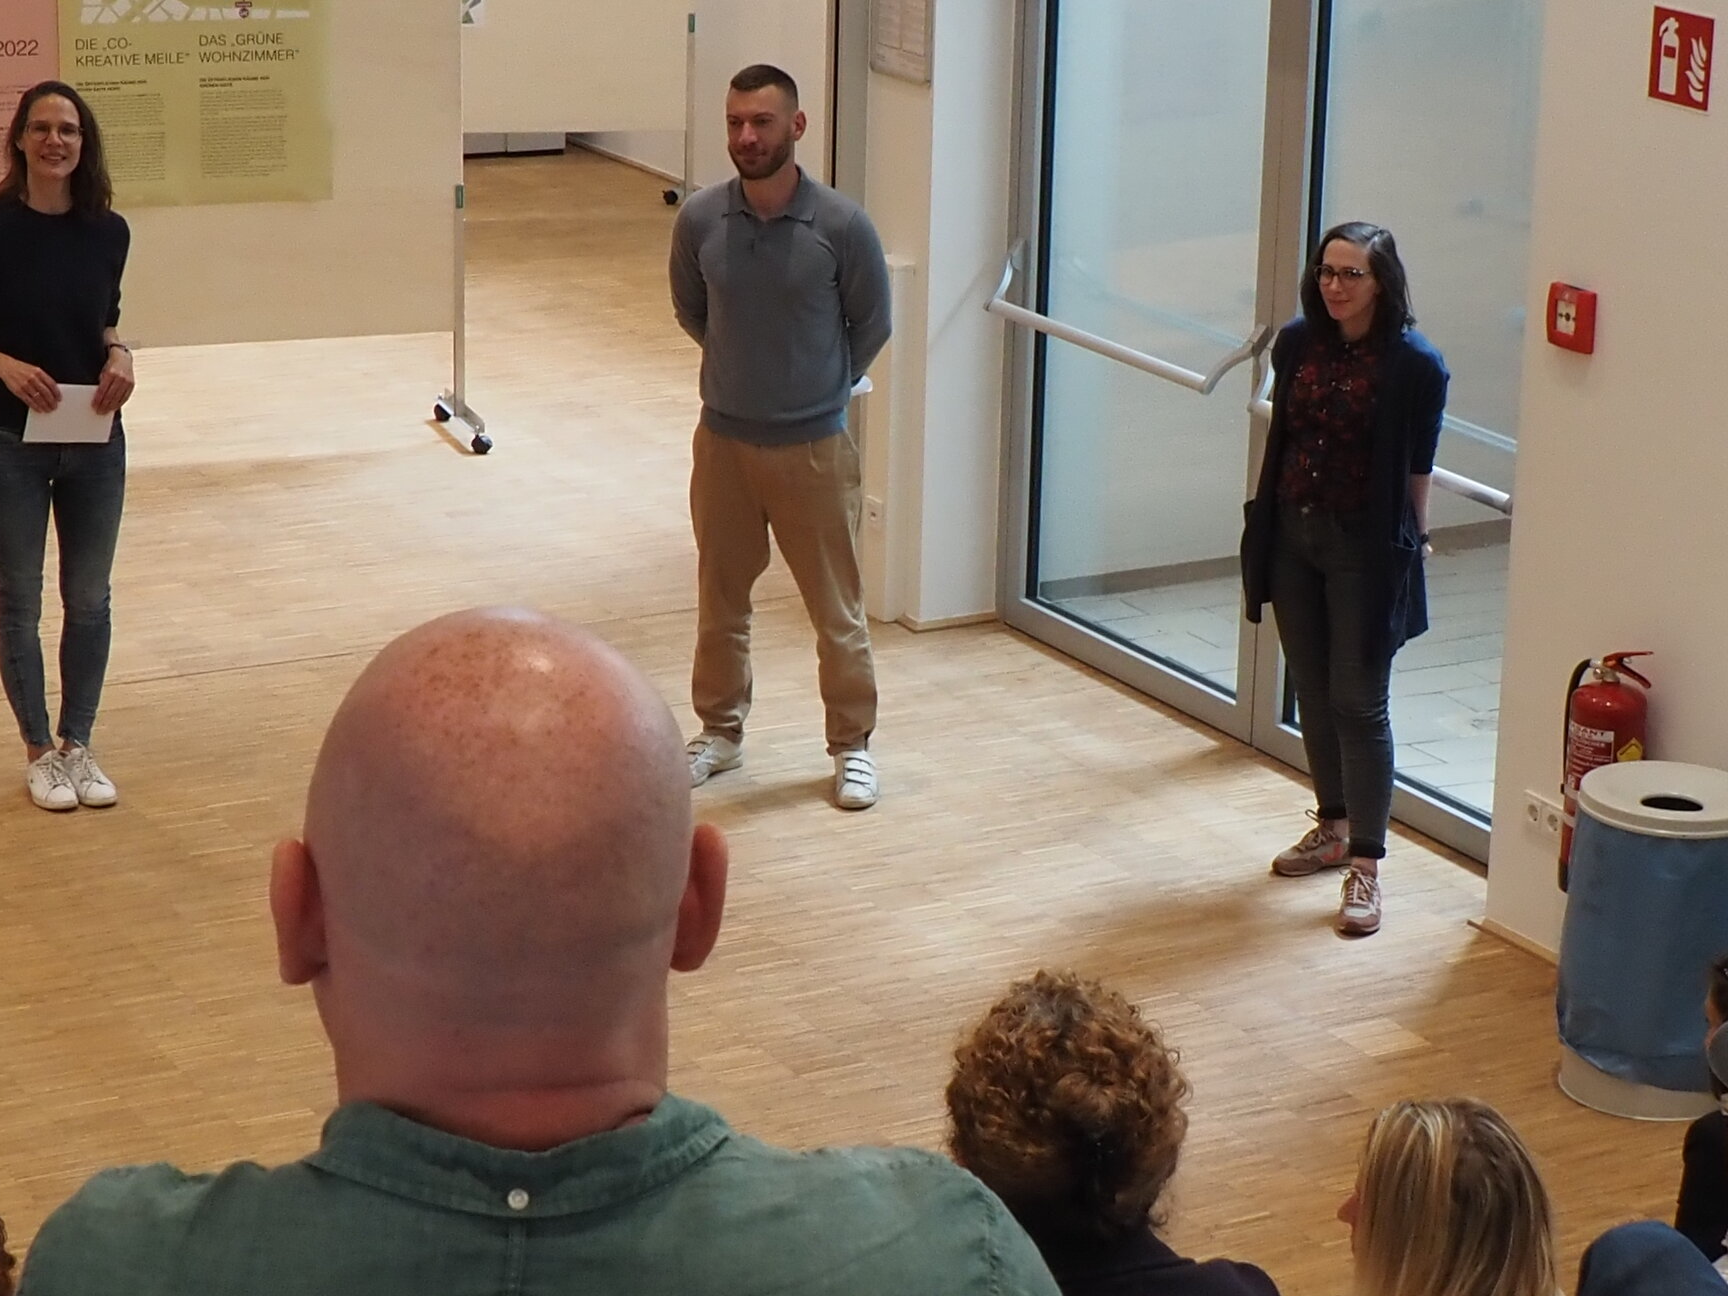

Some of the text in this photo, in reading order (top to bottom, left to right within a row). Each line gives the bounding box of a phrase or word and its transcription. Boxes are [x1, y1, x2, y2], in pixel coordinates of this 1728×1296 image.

[75, 38, 98, 50] DIE
[199, 33, 227, 47] DAS
[75, 54, 141, 67] KREATIVE
